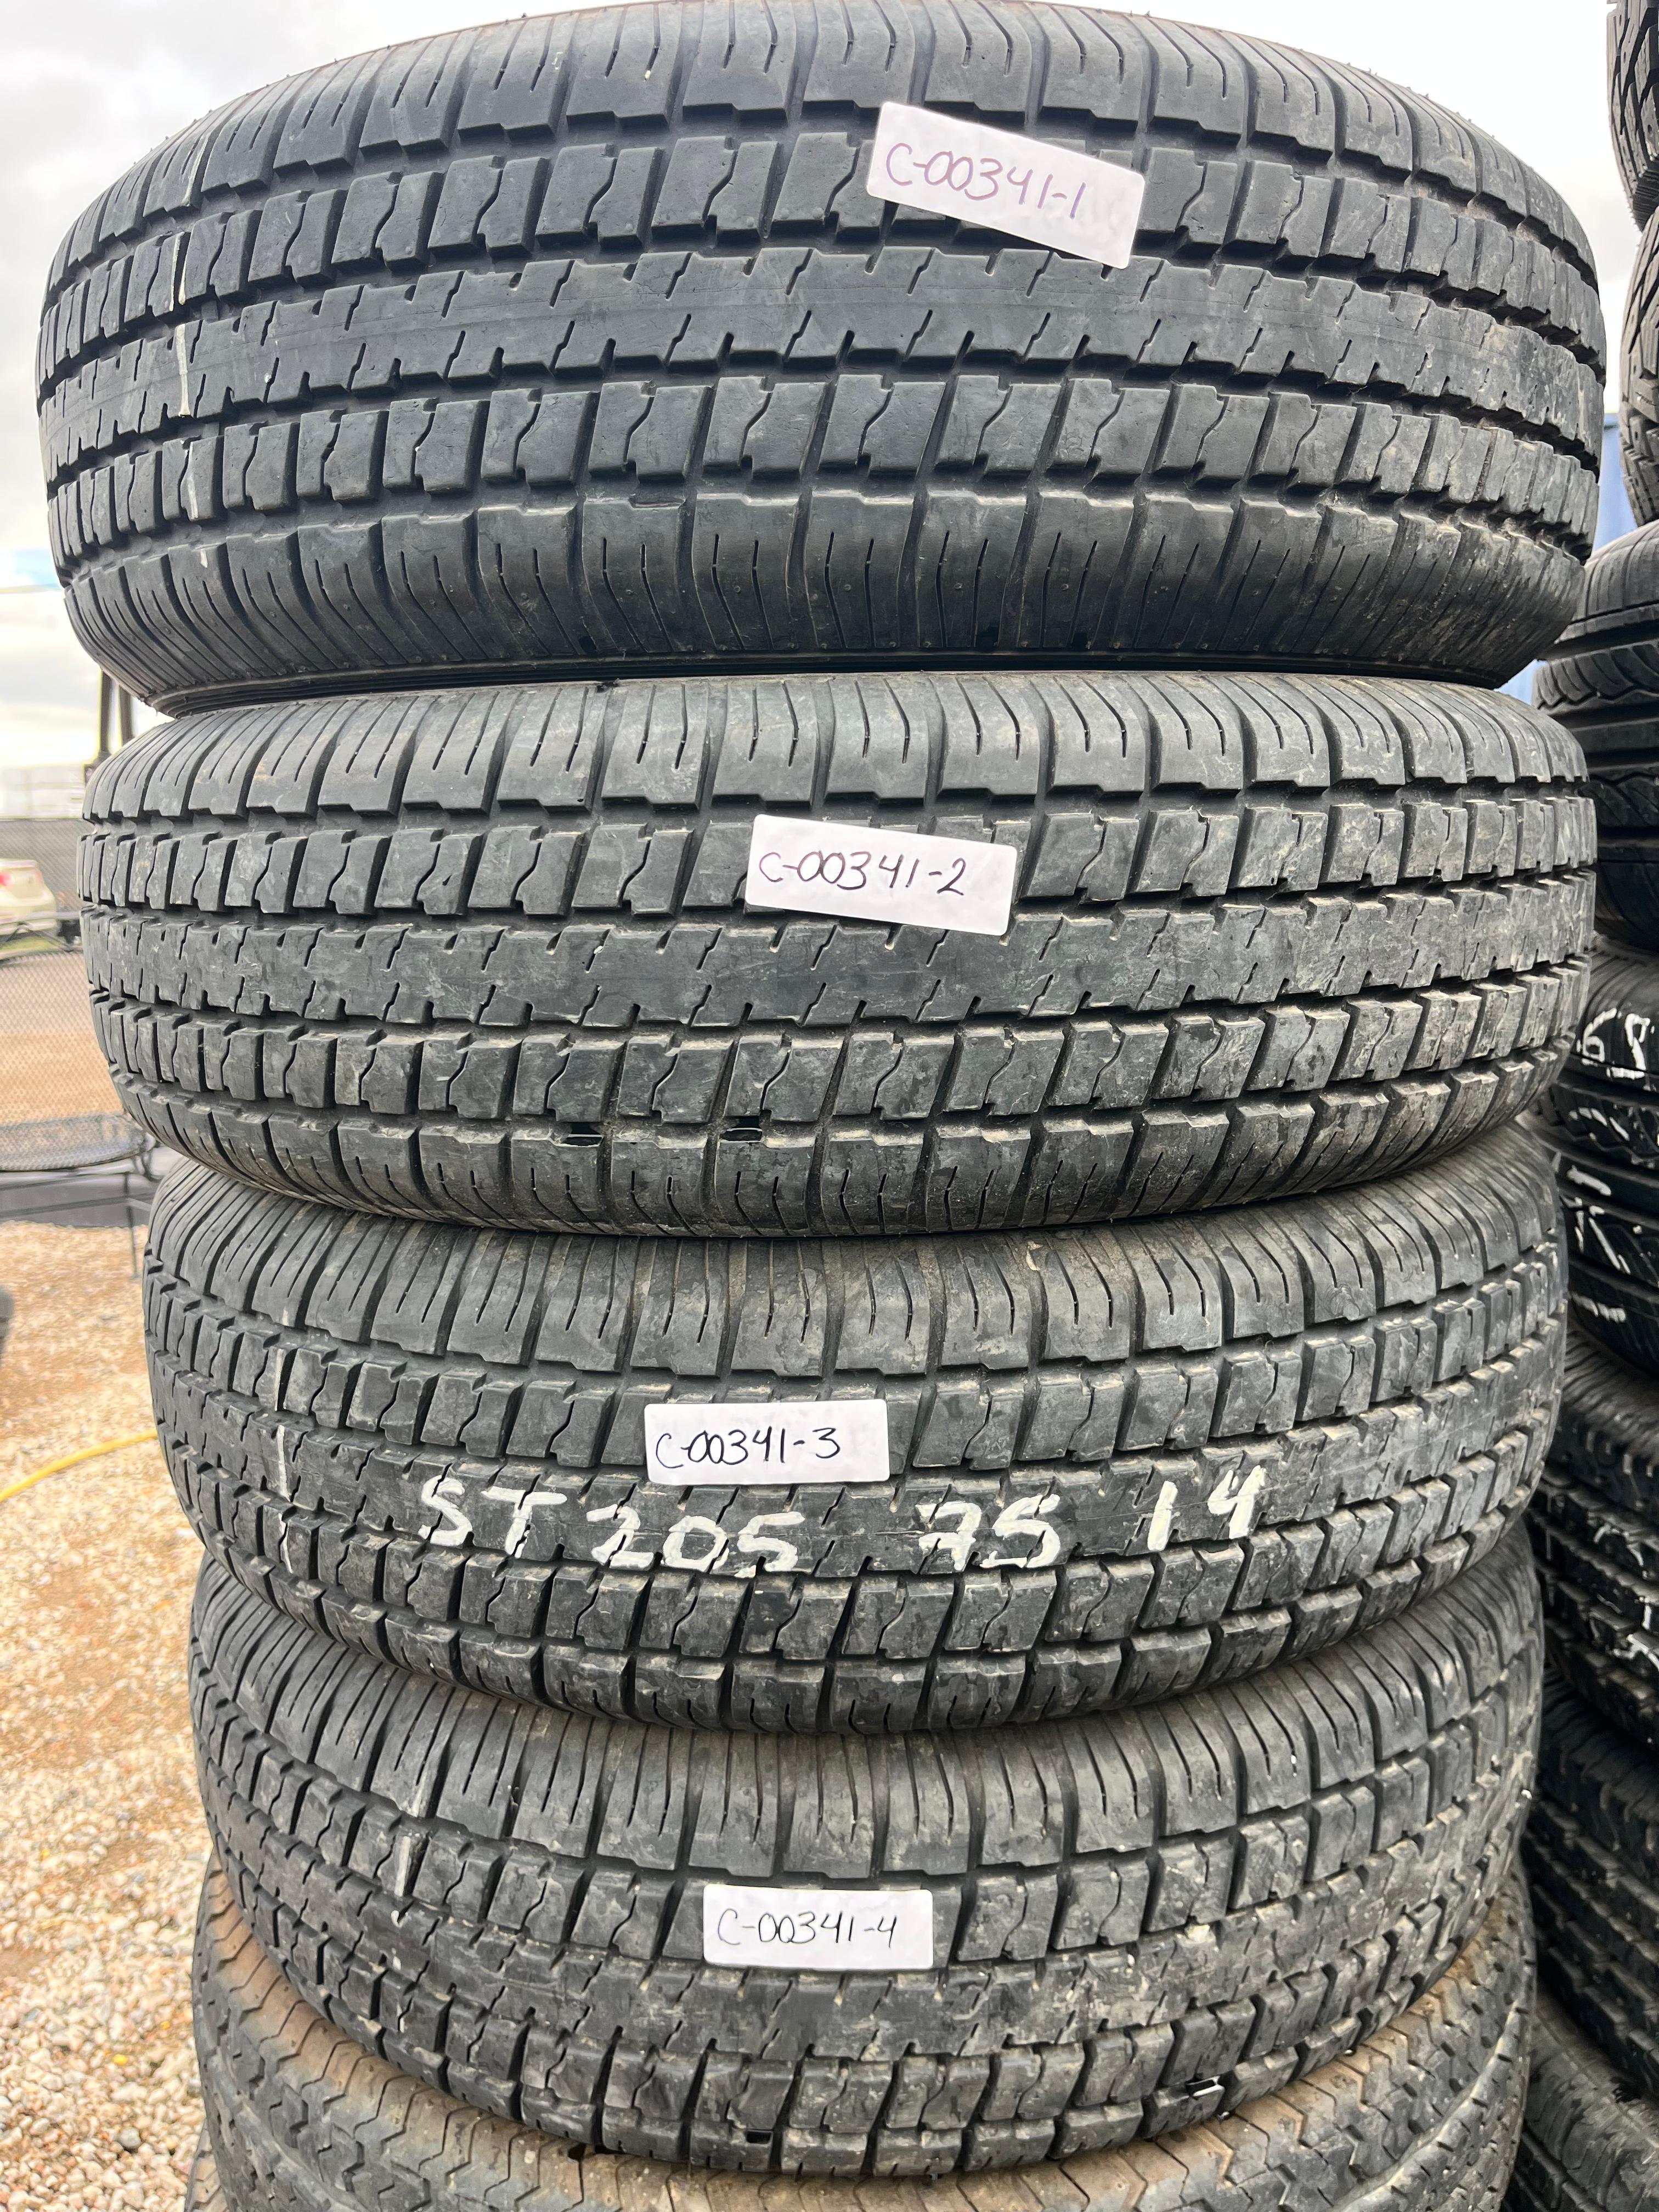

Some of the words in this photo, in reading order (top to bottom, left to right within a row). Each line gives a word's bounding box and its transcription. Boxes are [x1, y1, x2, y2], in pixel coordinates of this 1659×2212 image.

[885, 142, 1086, 219] C-00341-1
[759, 850, 967, 896] C-00341-2
[656, 1425, 841, 1469] C-00341-3
[417, 1475, 568, 1559] ST
[586, 1503, 806, 1578] 205
[915, 1493, 1060, 1571] 75
[1147, 1464, 1266, 1552] 14
[718, 1908, 898, 1948] C-00341-4
